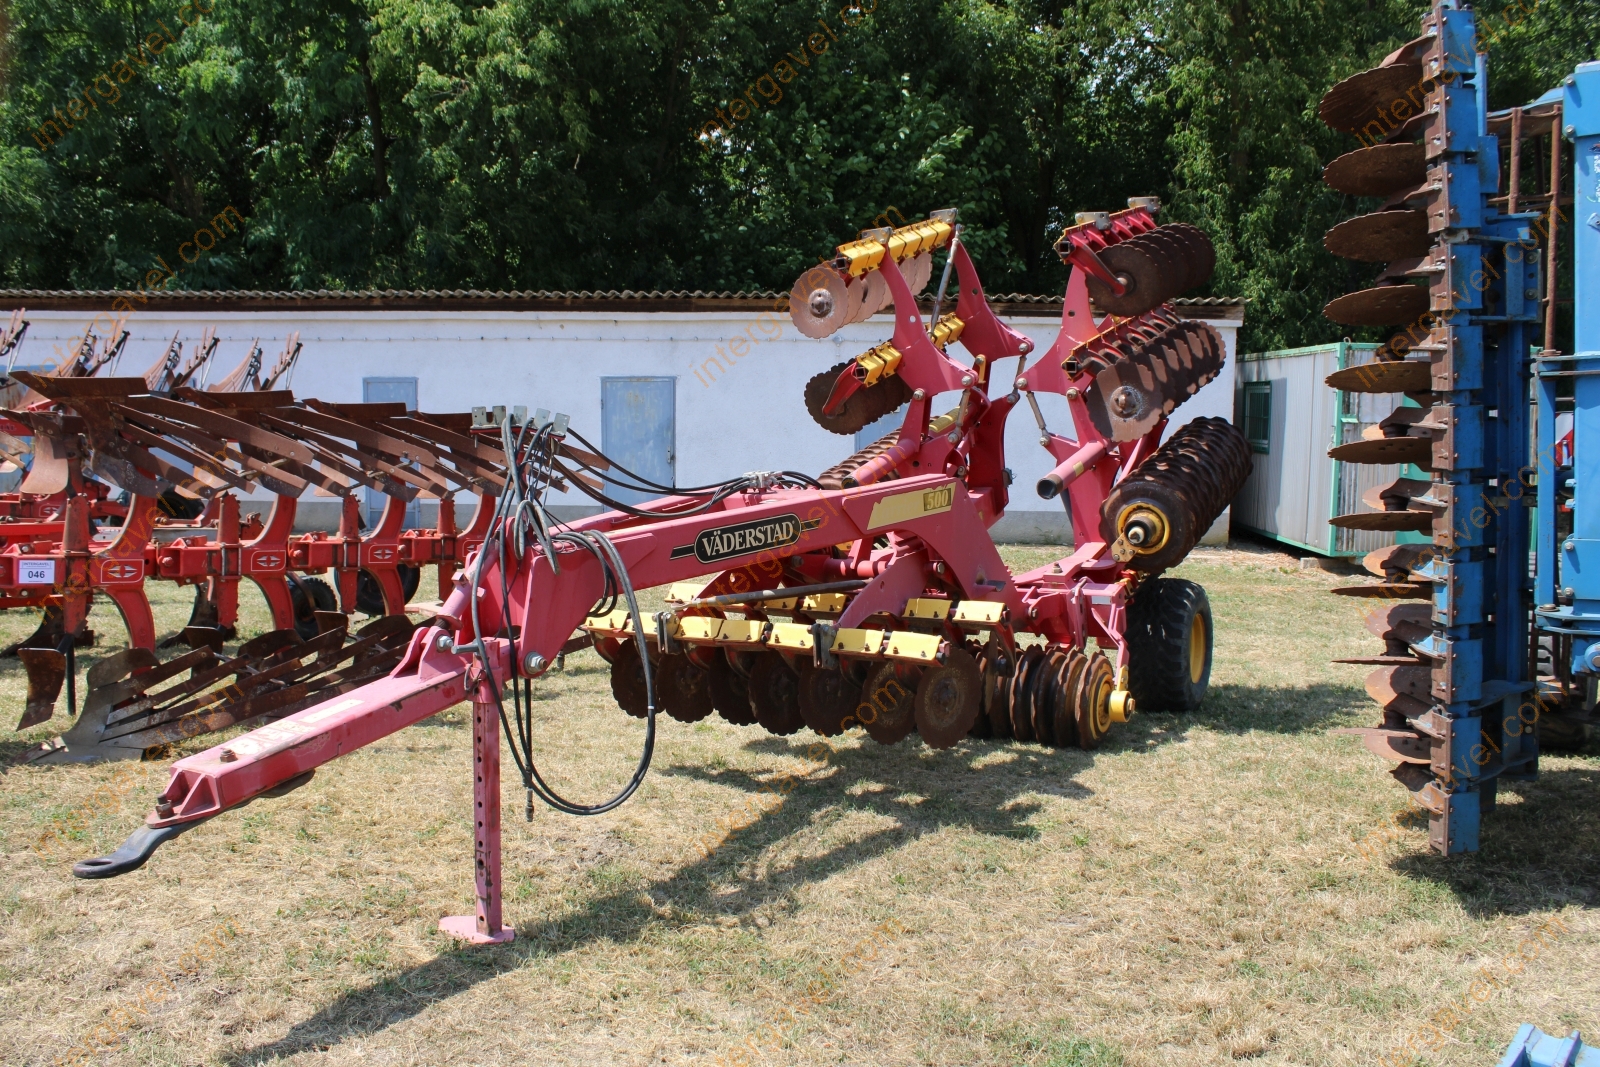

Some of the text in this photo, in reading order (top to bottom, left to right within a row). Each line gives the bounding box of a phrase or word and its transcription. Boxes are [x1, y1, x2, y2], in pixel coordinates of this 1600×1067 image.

[927, 489, 949, 510] 500
[702, 520, 794, 557] VÄDERSTAD
[27, 570, 45, 579] 046
